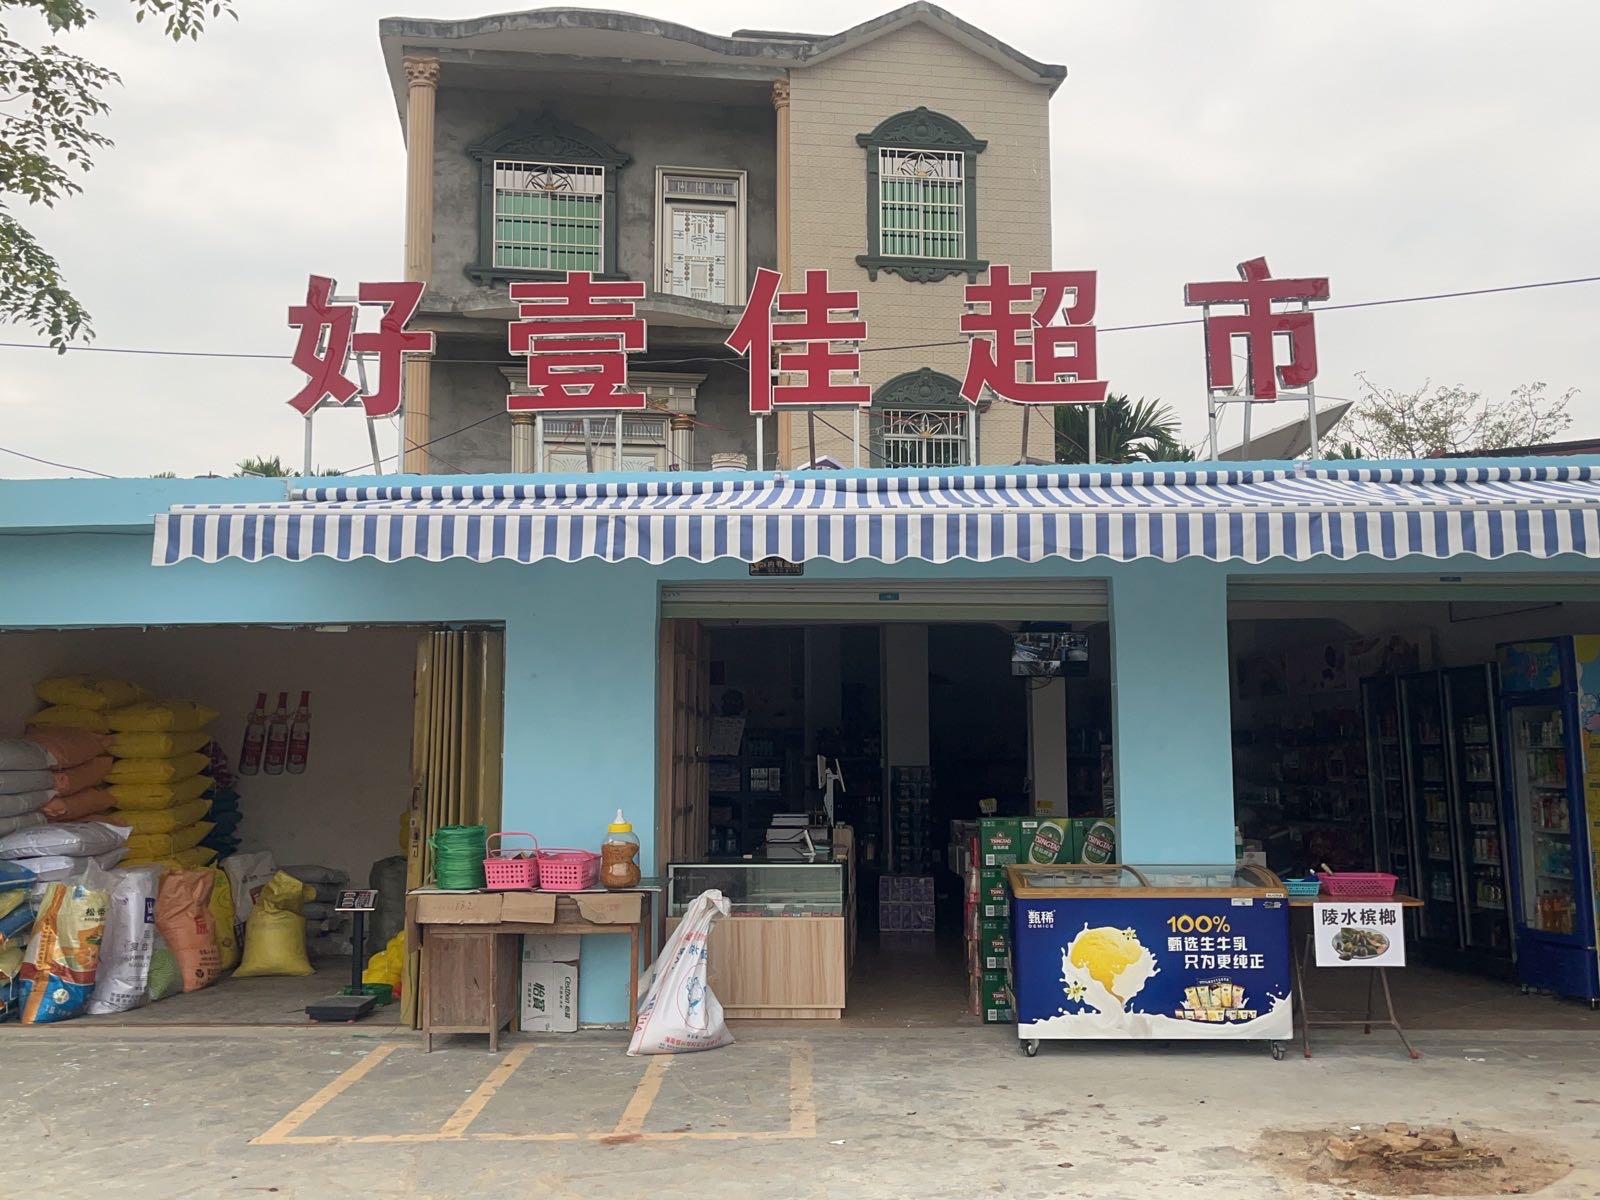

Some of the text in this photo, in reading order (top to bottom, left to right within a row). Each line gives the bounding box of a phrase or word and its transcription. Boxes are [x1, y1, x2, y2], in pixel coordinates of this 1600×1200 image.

[1035, 835, 1060, 851] TSINGTAO
[1167, 915, 1231, 933] 100%
[1321, 908, 1396, 926] 陵水槟榔
[1167, 936, 1248, 952] 甄选生牛乳
[1184, 954, 1264, 969] 只为更纯正
